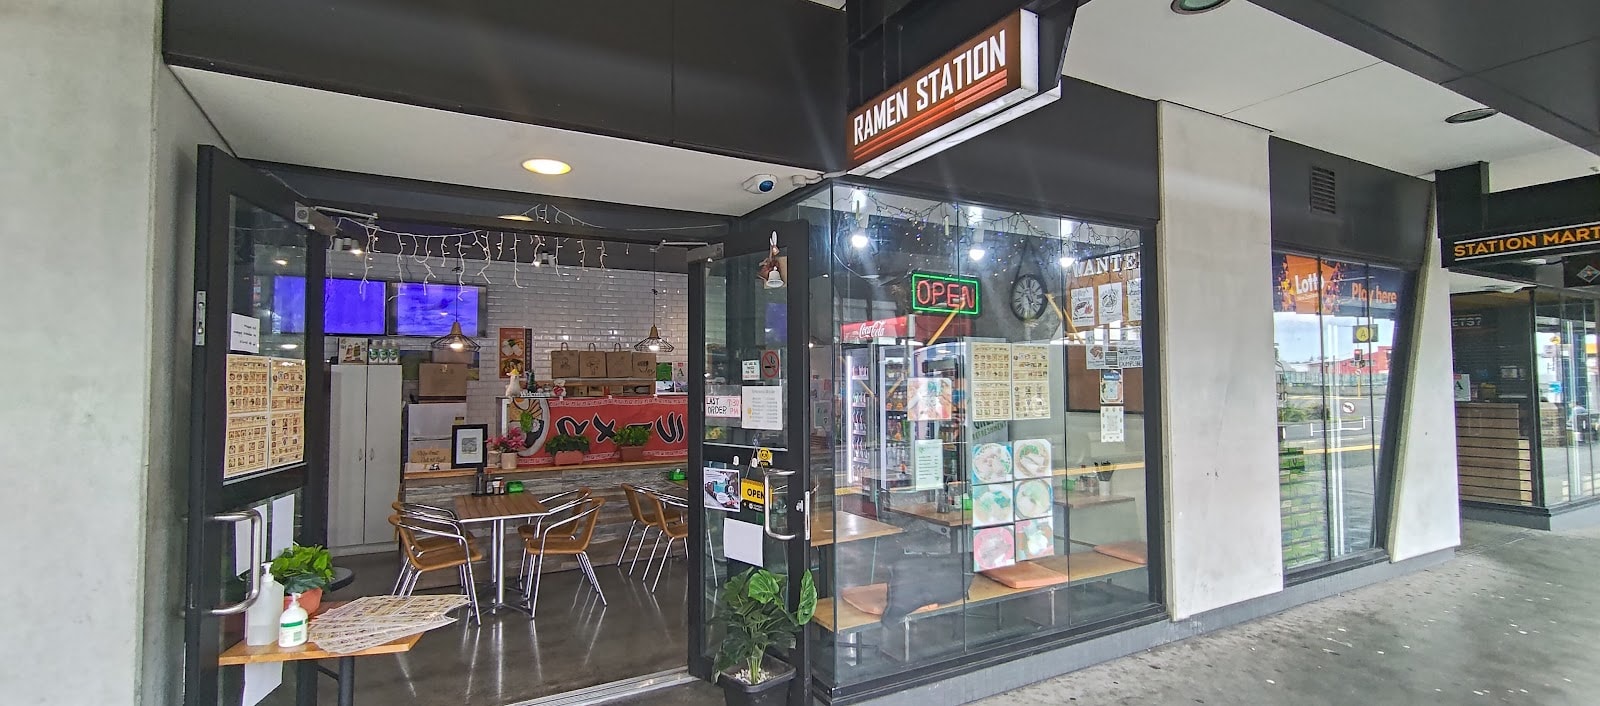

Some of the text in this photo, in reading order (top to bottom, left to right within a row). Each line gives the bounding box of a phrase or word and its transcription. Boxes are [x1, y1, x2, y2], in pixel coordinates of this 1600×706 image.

[853, 30, 1006, 146] RAMEN STATION
[1454, 226, 1600, 257] STATION MART
[1071, 252, 1140, 277] WANTE
[917, 280, 975, 309] OPEN
[1376, 285, 1397, 304] here
[859, 321, 887, 338] Coca-Cola
[1452, 317, 1482, 327] ETS?
[677, 368, 684, 377] A
[706, 397, 720, 406] LAST
[707, 405, 728, 415] ORDER
[747, 488, 765, 499] OPEN
